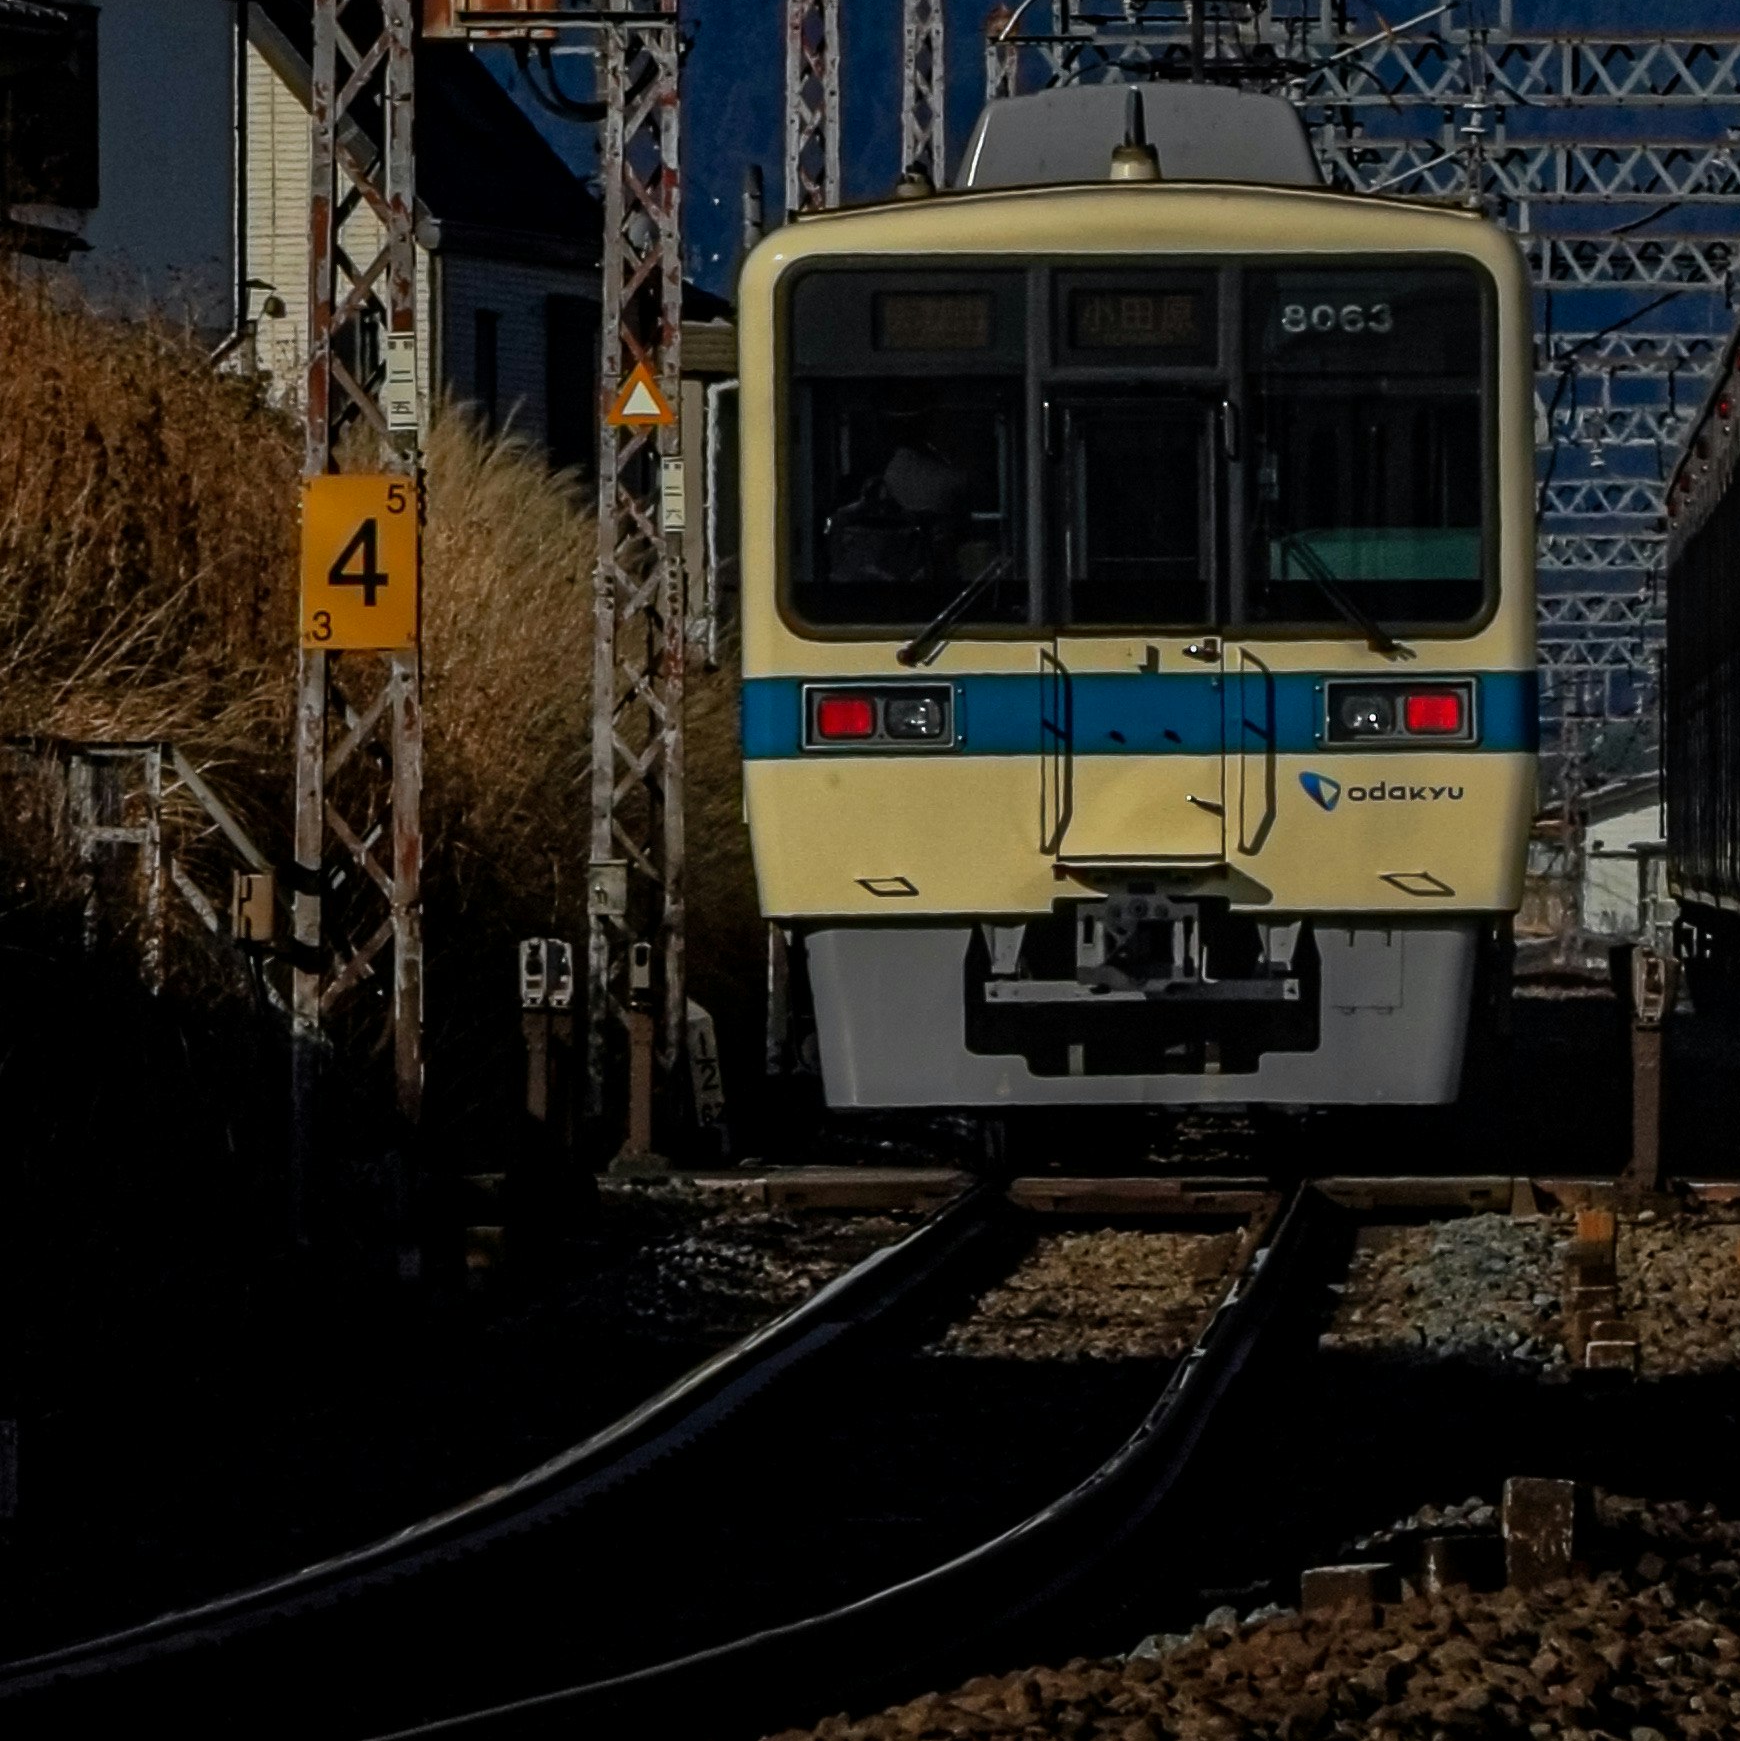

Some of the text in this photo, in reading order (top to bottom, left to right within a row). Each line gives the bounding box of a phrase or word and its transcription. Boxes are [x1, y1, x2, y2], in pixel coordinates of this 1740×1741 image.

[1281, 304, 1393, 332] 8063
[387, 484, 406, 514] 5
[328, 518, 388, 607] 4
[312, 611, 332, 641] 3
